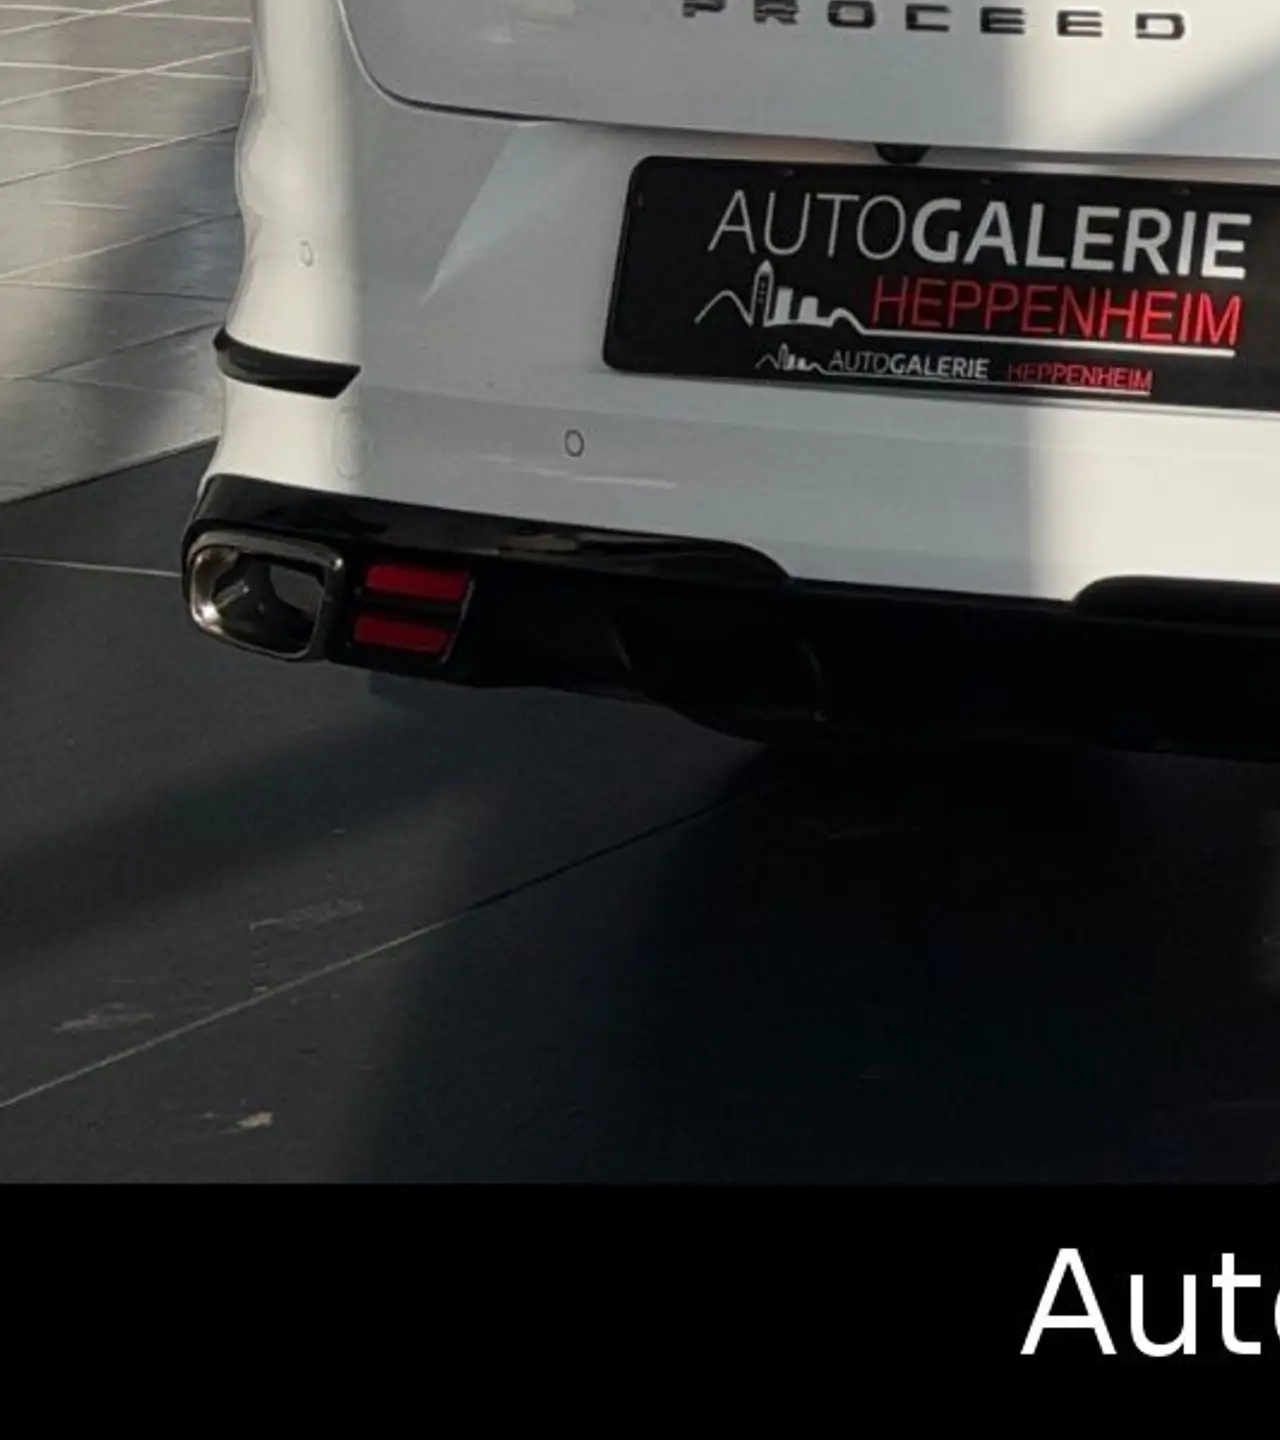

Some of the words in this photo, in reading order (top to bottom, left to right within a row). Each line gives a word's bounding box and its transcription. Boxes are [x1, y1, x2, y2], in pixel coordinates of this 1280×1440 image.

[707, 188, 1253, 281] AUTOGALERIE
[870, 274, 1242, 347] HEPPENHEIM
[828, 349, 990, 380] AUTOGALERIE
[1006, 361, 1153, 390] HEPPENHEIM
